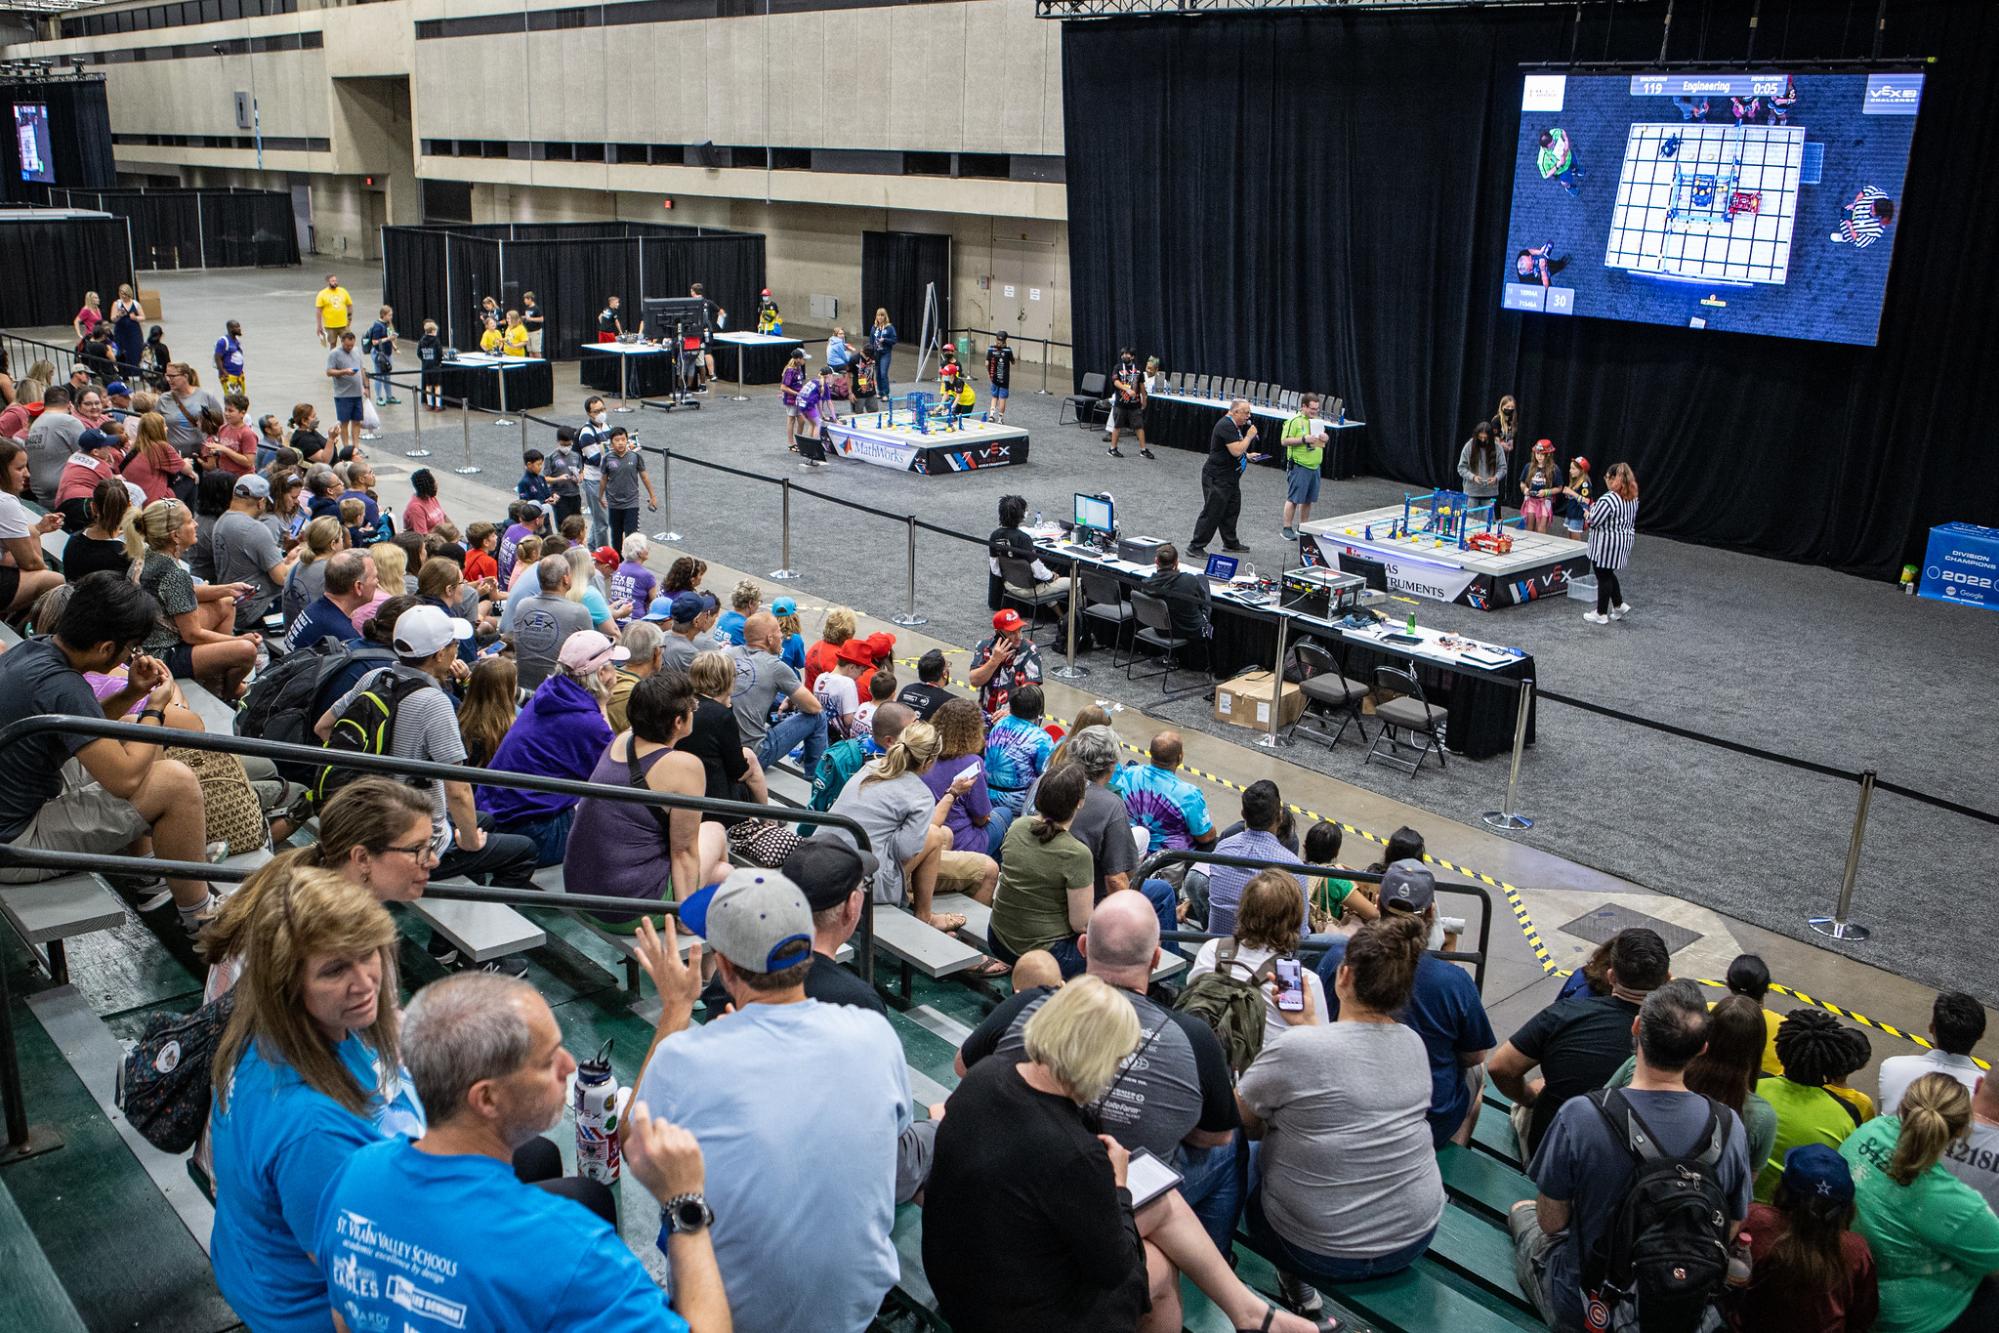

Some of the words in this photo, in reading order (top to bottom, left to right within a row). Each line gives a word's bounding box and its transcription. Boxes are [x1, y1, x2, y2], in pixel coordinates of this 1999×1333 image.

[1643, 83, 1663, 94] 119
[1682, 80, 1730, 93] Engineering
[1753, 83, 1778, 94] 0:05
[1870, 85, 1901, 98] VEX
[1553, 294, 1567, 307] 30
[854, 439, 905, 465] MathWorks
[979, 442, 1011, 459] VEX
[1944, 555, 1997, 570] CHAMPIONS
[1952, 550, 1990, 562] DIVISION
[1542, 564, 1573, 587] VEX
[1941, 570, 1993, 589] 2022
[1960, 589, 1984, 600] Google
[523, 615, 555, 629] VEX
[348, 1218, 378, 1246] VRAIN
[378, 1231, 412, 1259] VALLEY
[411, 1244, 458, 1278] SCHOOLS
[342, 1239, 374, 1256] academic
[375, 1250, 411, 1271] excellence
[410, 1262, 421, 1277] by
[420, 1265, 445, 1284] design
[333, 1264, 379, 1299] EAGLES
